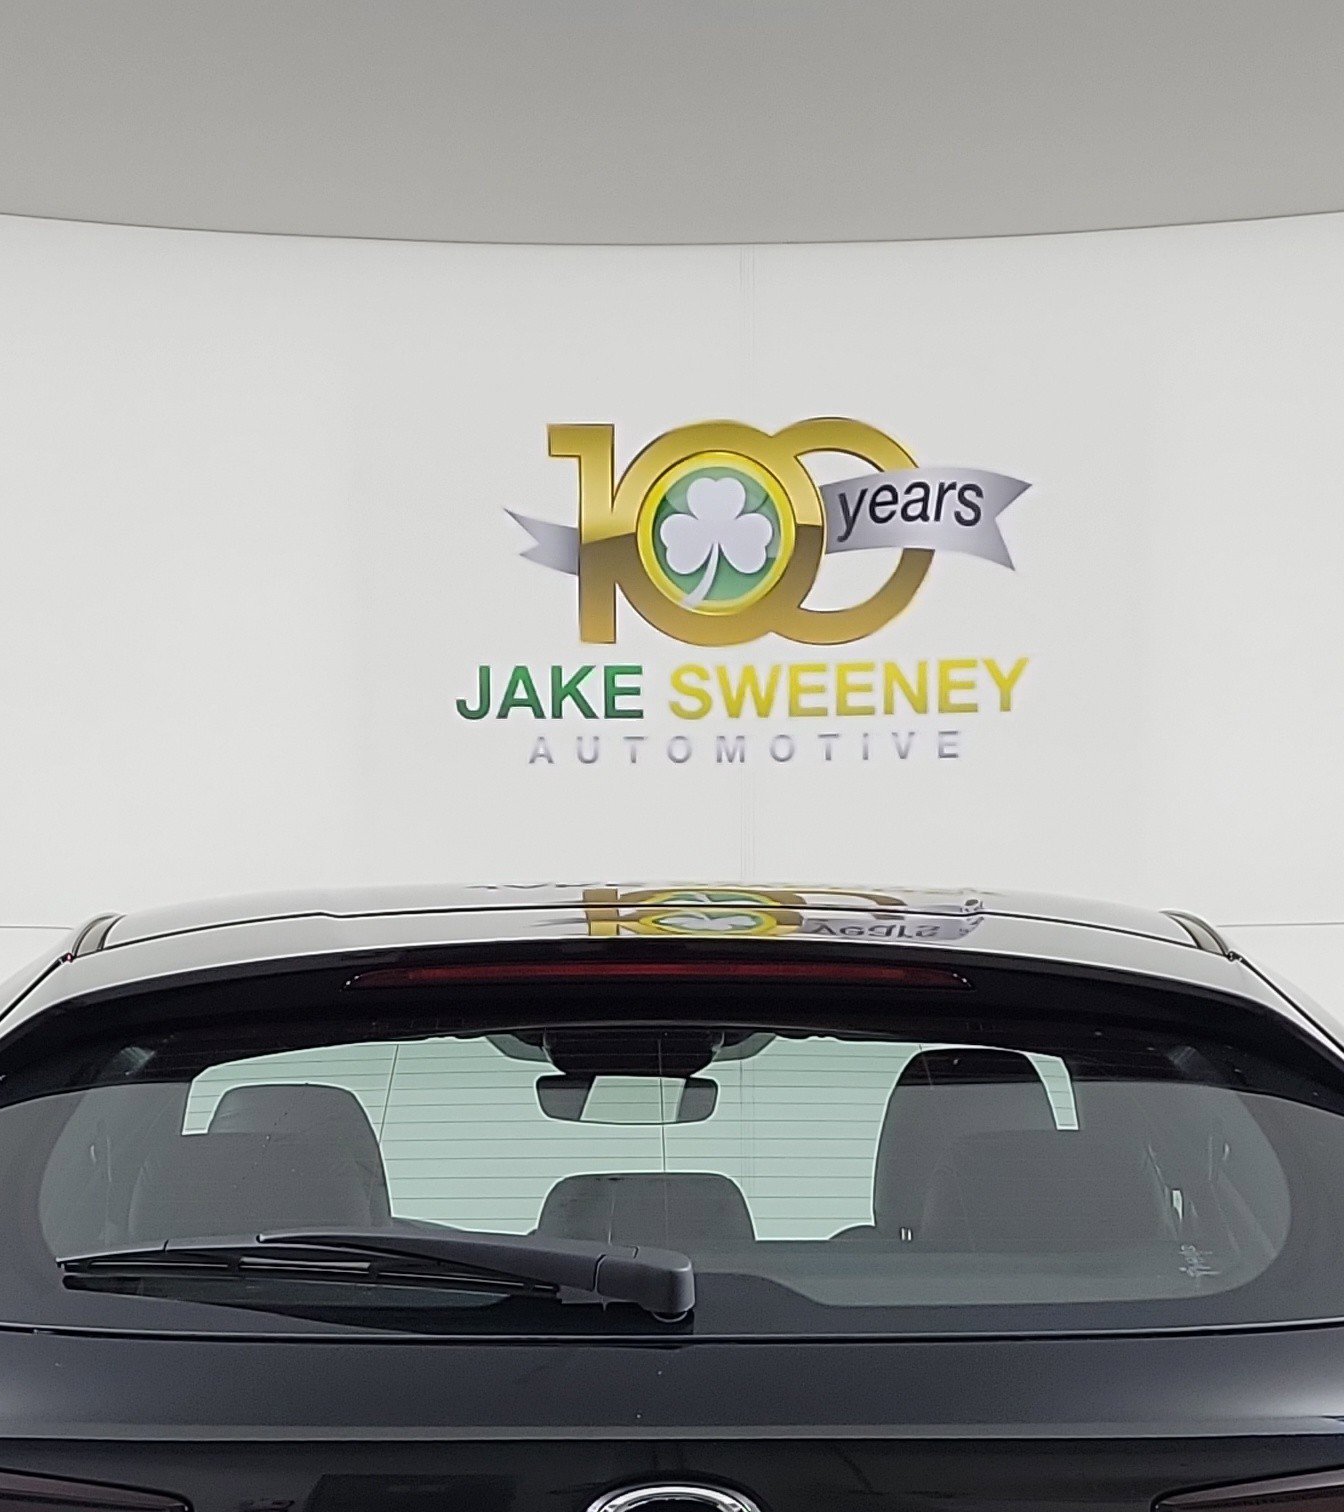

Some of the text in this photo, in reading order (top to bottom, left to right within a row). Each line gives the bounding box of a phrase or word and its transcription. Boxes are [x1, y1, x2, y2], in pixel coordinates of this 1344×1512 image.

[546, 416, 985, 647] 100 years
[455, 657, 1030, 721] JAKE SWEENEY
[528, 730, 962, 765] AUTOMOTIVE
